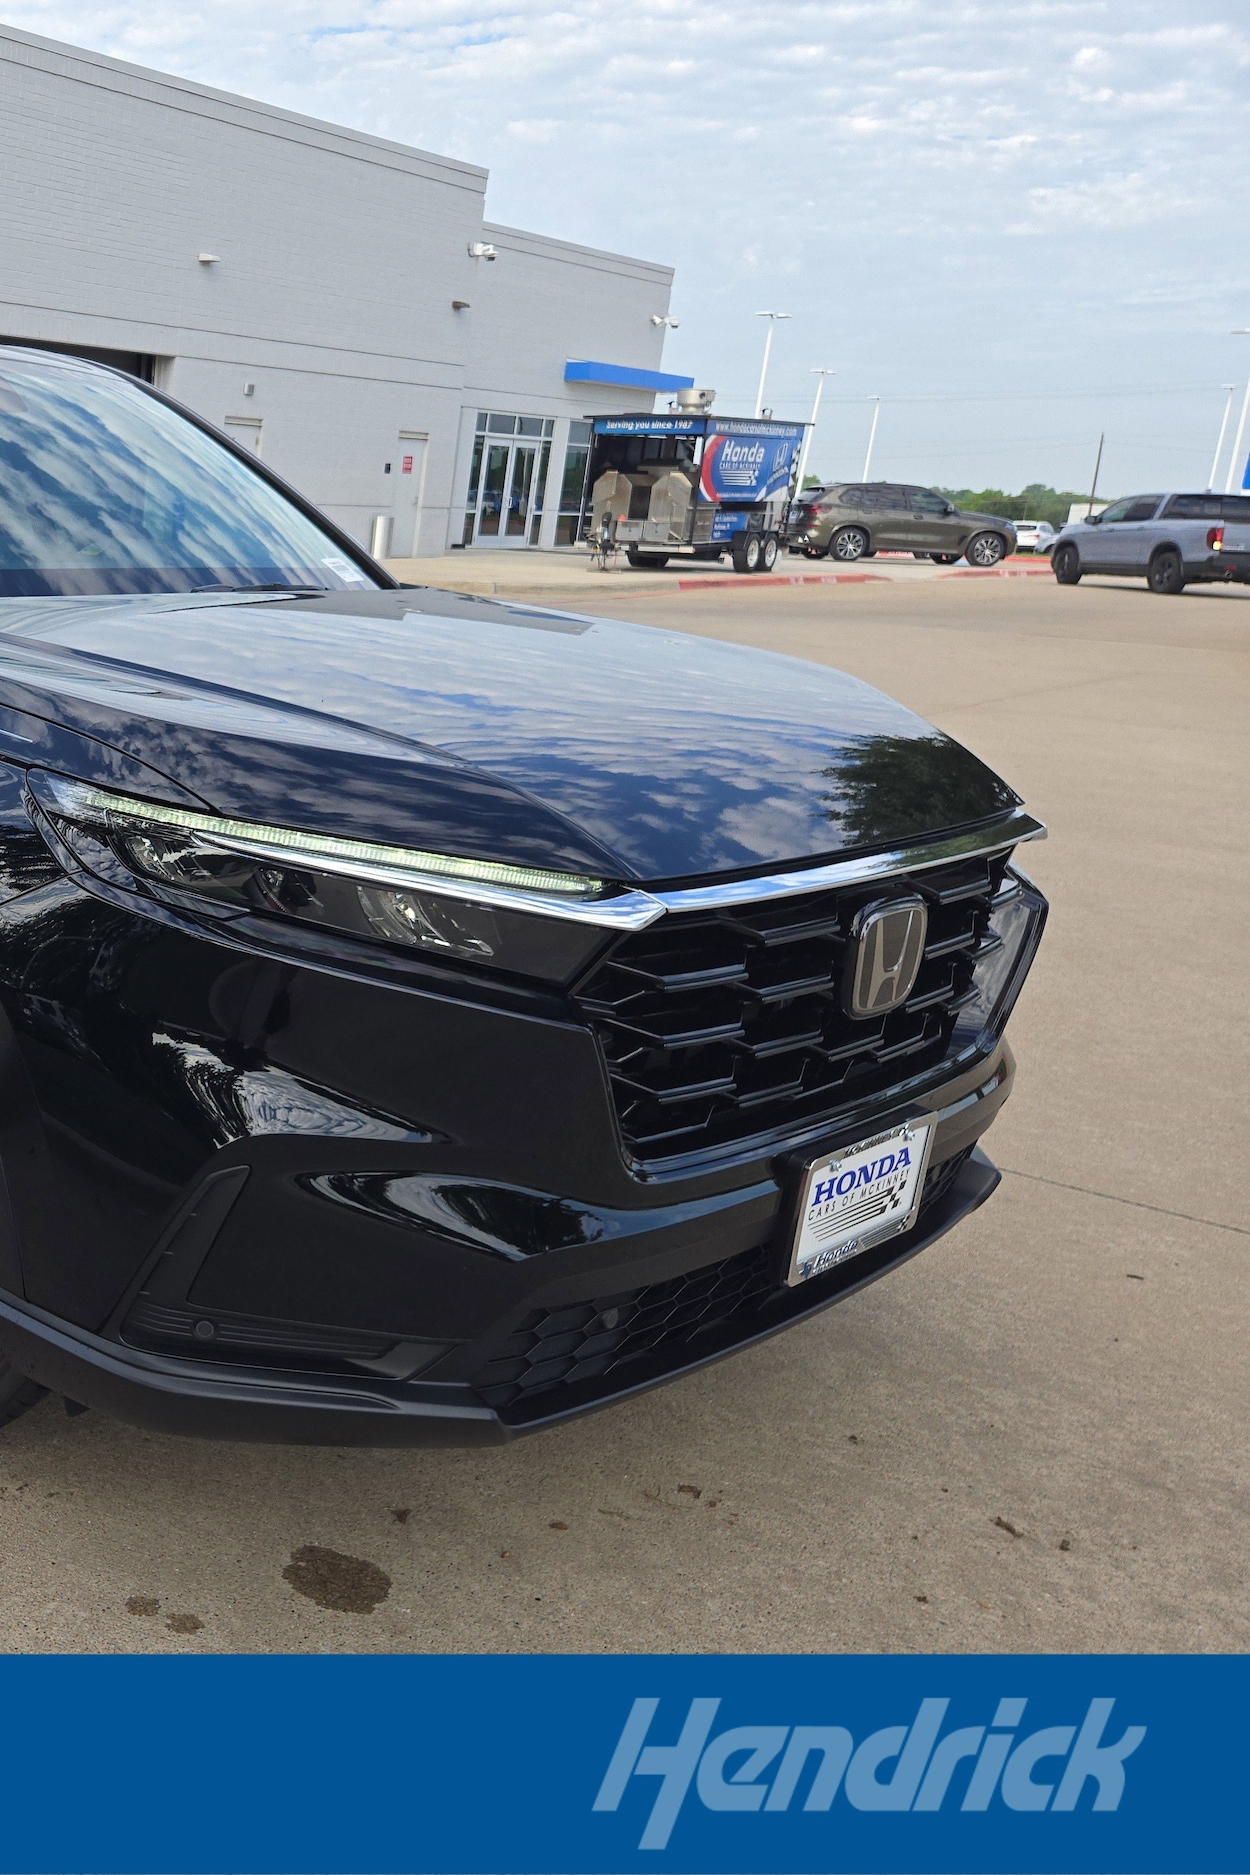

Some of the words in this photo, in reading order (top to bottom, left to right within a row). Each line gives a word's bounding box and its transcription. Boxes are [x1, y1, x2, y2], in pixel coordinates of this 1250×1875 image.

[635, 421, 650, 430] you
[721, 440, 766, 463] Honda
[807, 1200, 836, 1222] CARS
[841, 1193, 855, 1207] OF
[859, 1168, 911, 1198] MCKINNEY
[810, 1146, 912, 1207] HONDA
